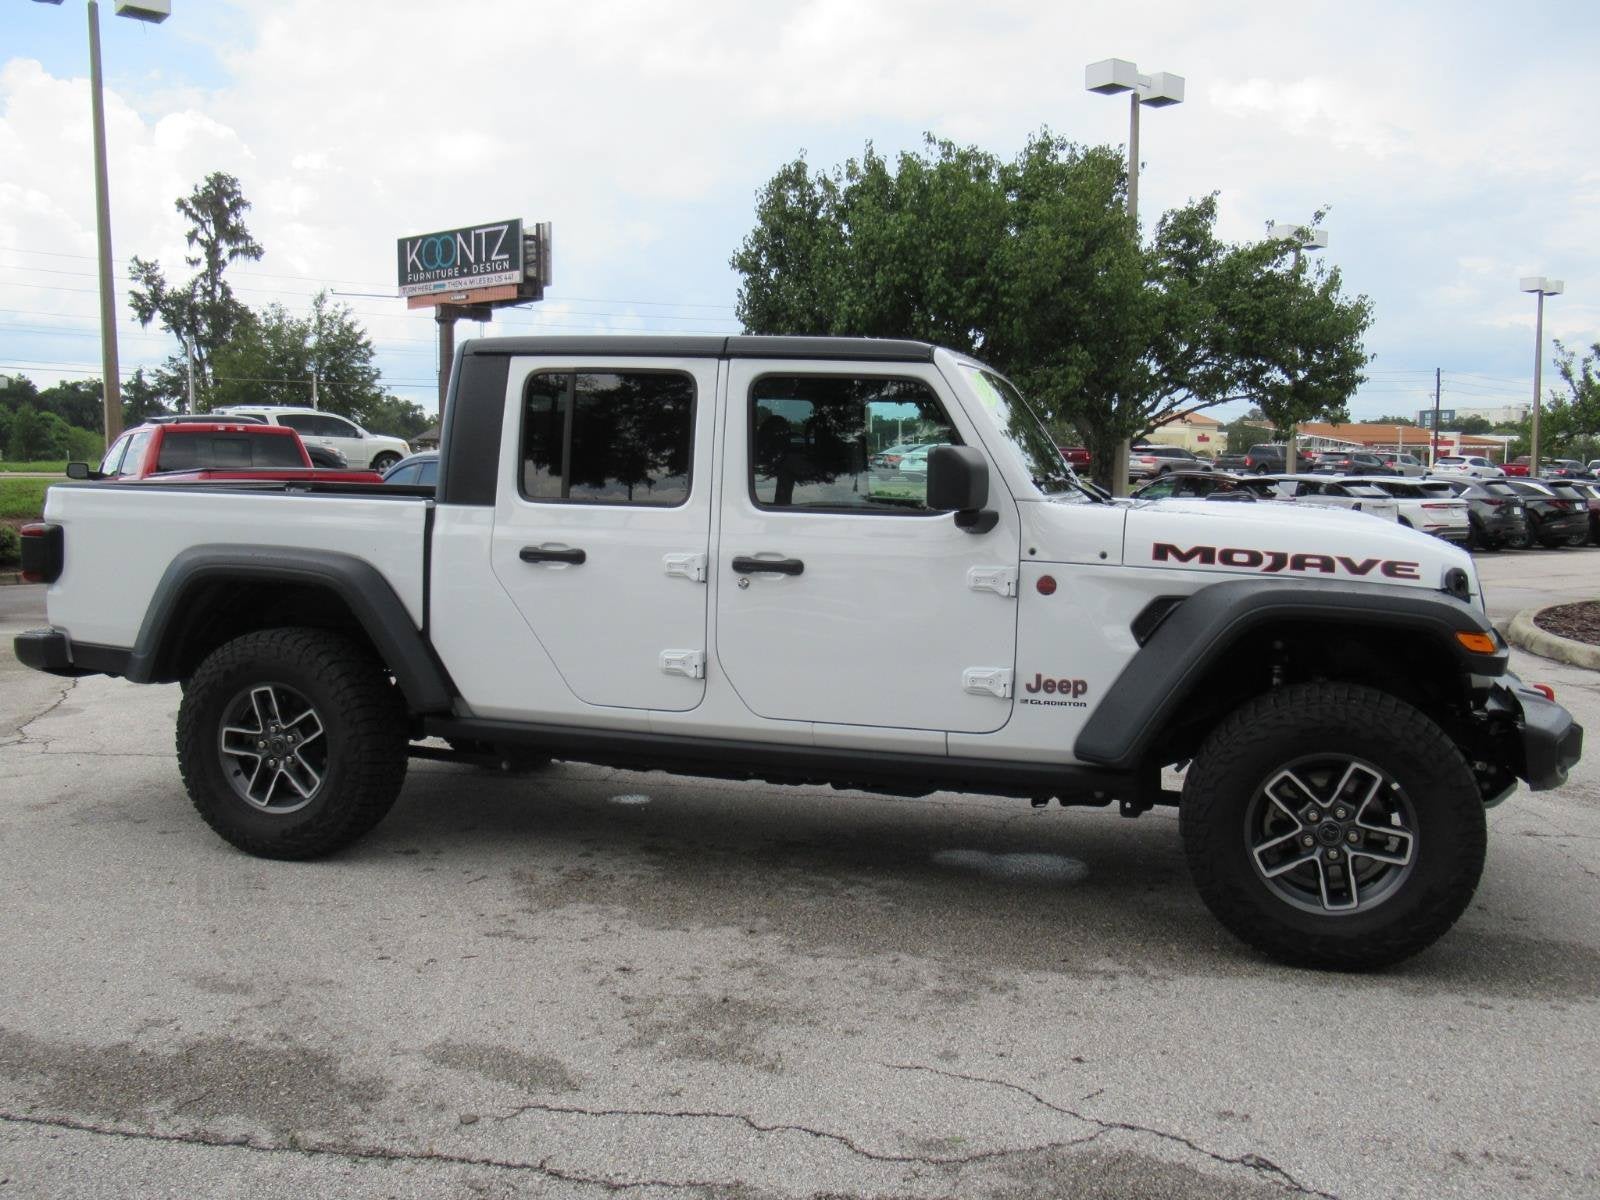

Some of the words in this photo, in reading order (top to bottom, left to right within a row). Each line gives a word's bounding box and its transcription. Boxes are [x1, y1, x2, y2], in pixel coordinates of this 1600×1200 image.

[407, 225, 509, 273] KOONTZ
[407, 267, 459, 282] FURNITURE
[472, 261, 510, 274] DESIGN
[447, 280, 463, 288] THEN
[468, 277, 486, 286] MILES
[1152, 542, 1421, 580] MOJAVE
[1026, 673, 1088, 698] Jeep
[1030, 699, 1087, 708] GLADIATOR
